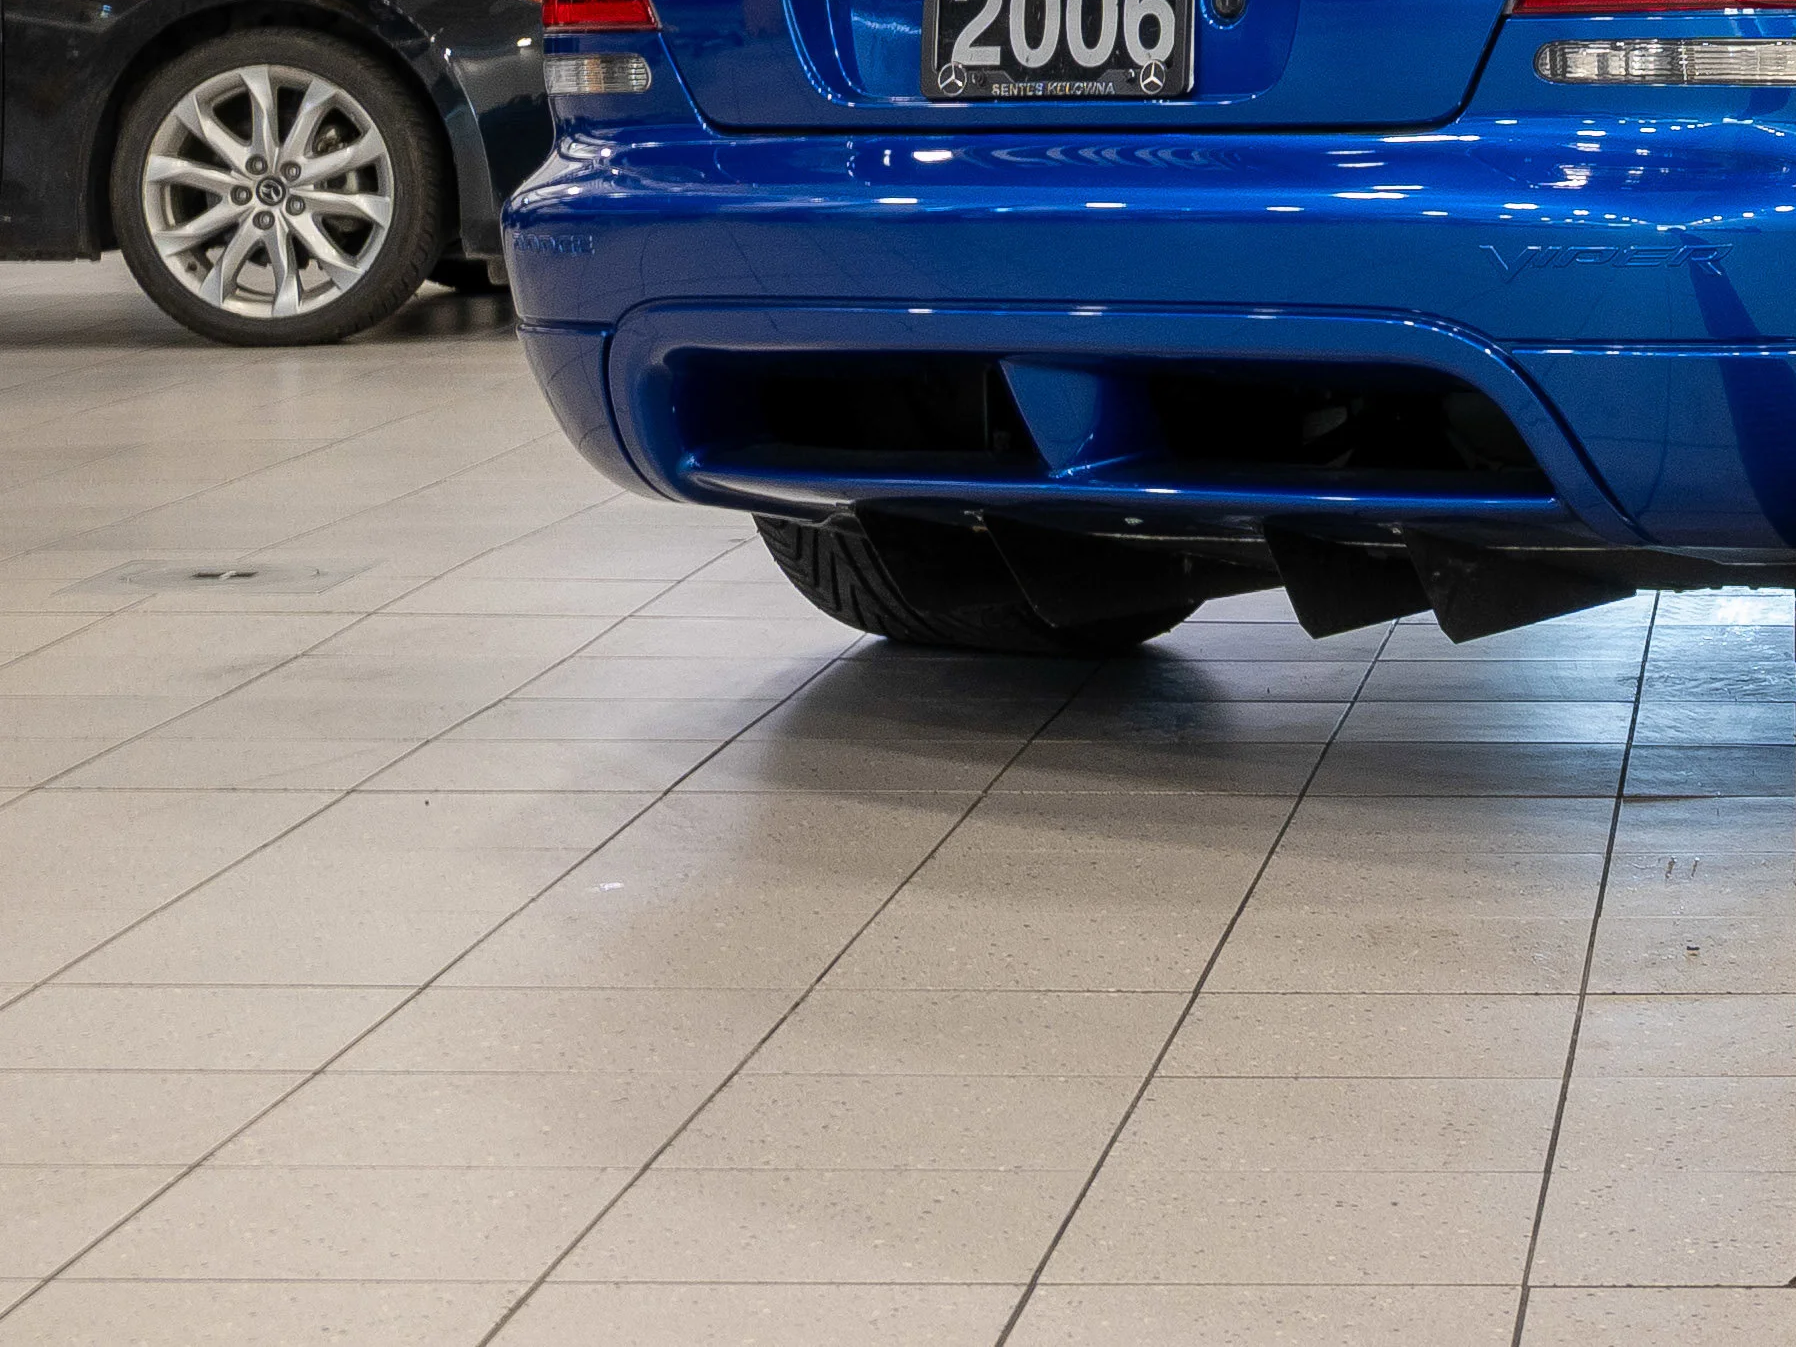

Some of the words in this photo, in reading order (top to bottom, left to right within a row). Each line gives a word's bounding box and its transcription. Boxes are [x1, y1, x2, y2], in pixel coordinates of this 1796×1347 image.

[991, 82, 1044, 97] SENTES
[1047, 81, 1116, 96] KELOWNA
[1478, 243, 1734, 284] VIPER
